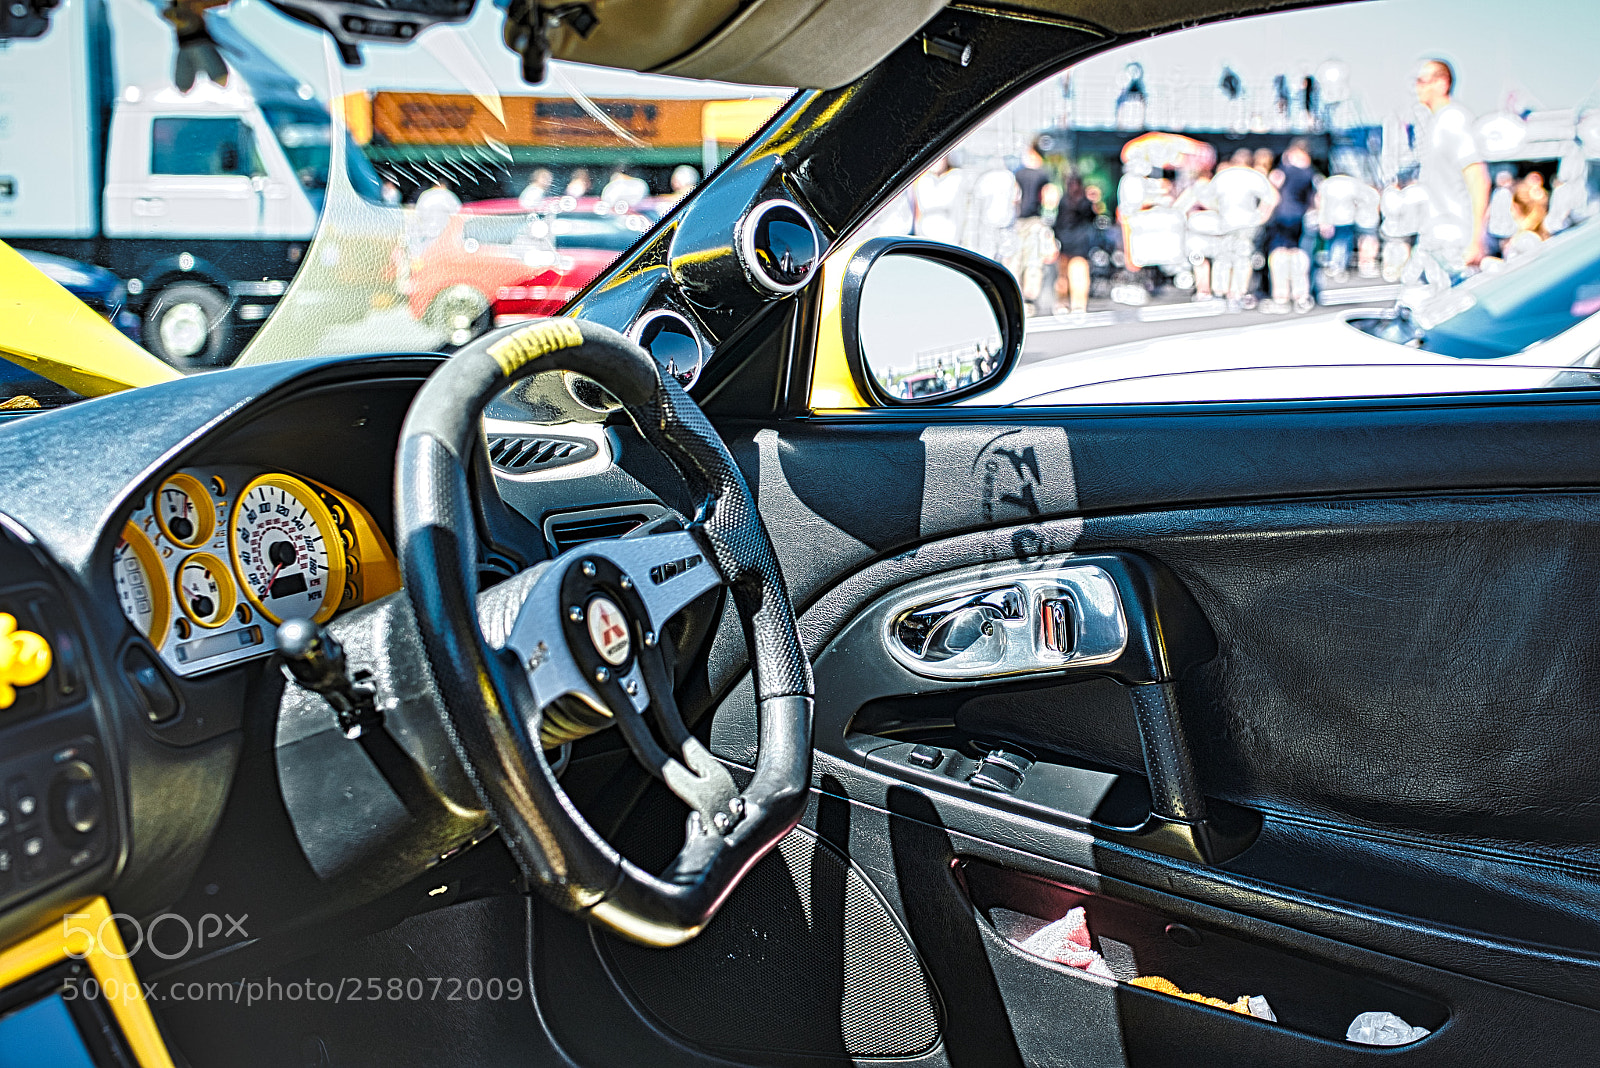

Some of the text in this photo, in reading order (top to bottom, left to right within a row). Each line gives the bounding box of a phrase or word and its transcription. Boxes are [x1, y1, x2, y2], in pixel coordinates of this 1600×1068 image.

[275, 504, 290, 517] 120
[291, 516, 306, 531] 140
[303, 535, 316, 552] 160
[241, 551, 251, 565] 40
[309, 557, 318, 576] 180
